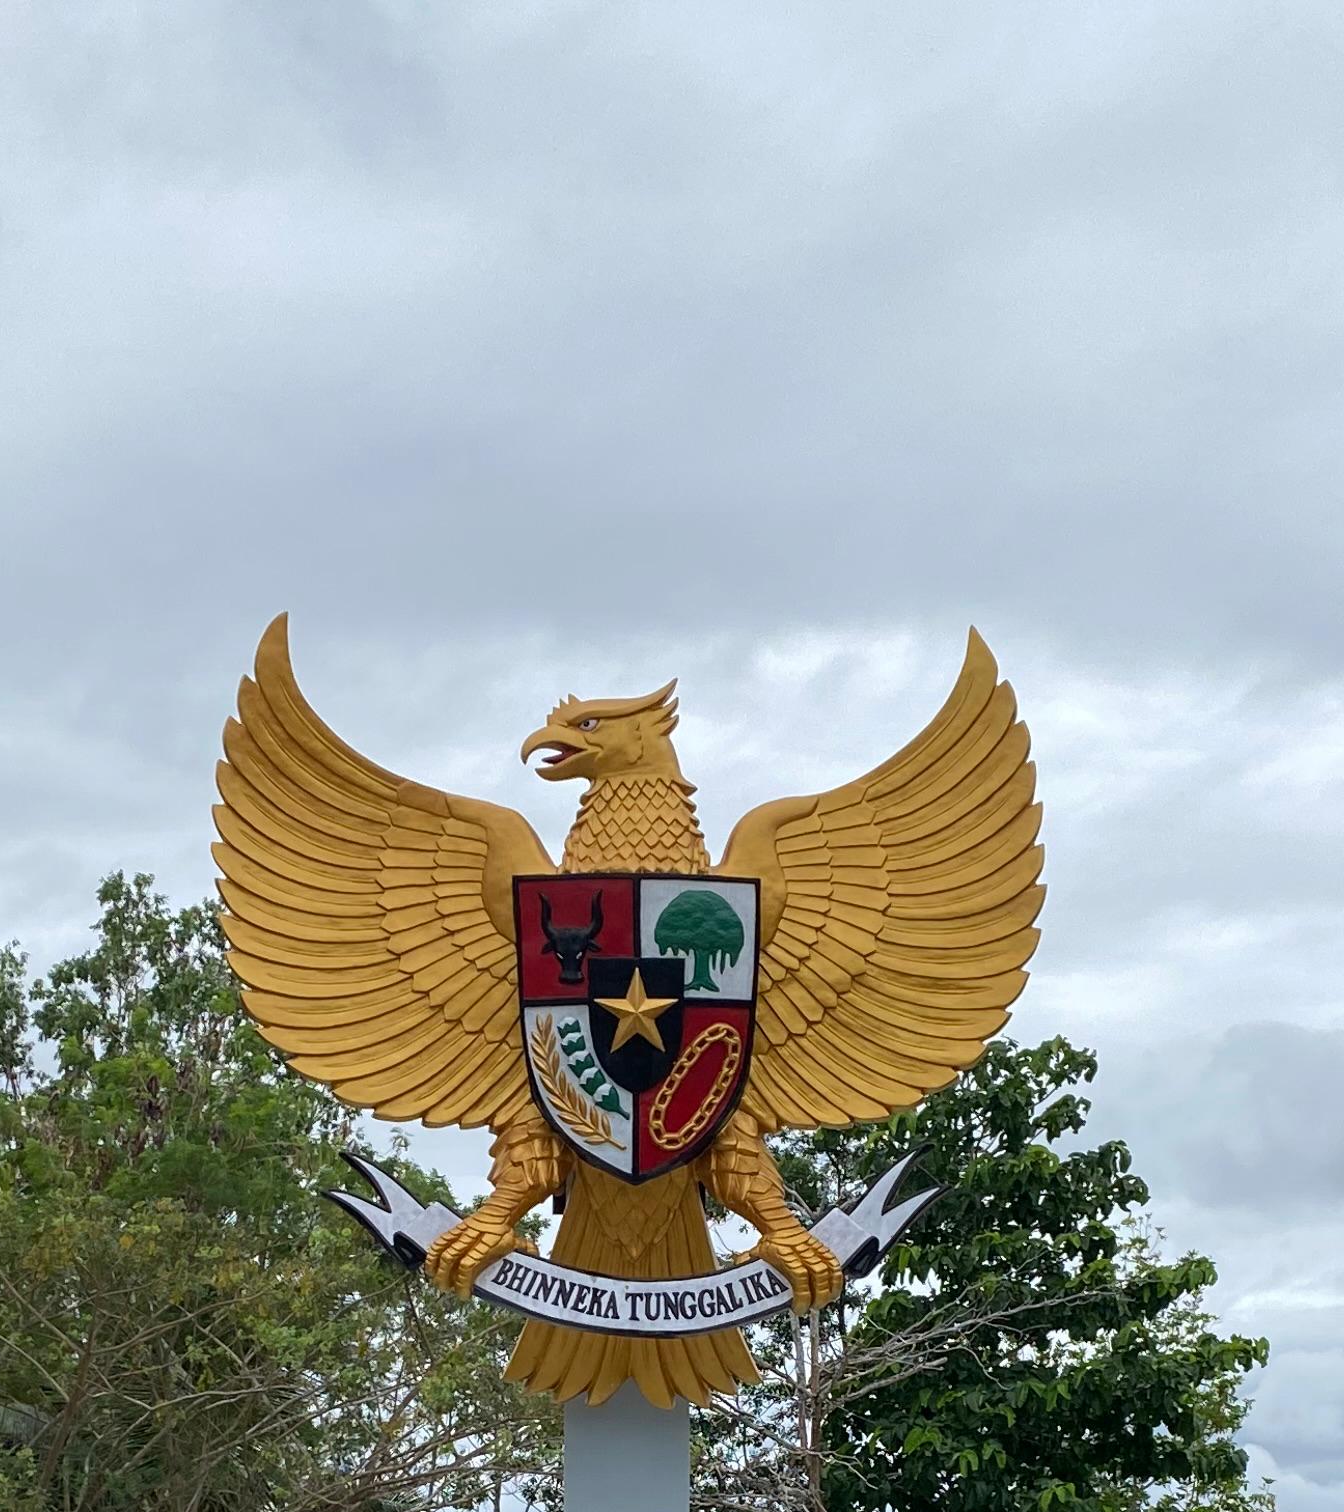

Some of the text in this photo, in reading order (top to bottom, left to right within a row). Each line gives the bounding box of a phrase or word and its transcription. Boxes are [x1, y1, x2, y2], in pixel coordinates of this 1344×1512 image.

[491, 1258, 789, 1321] BHINNEKA TUNGGAL IKA
